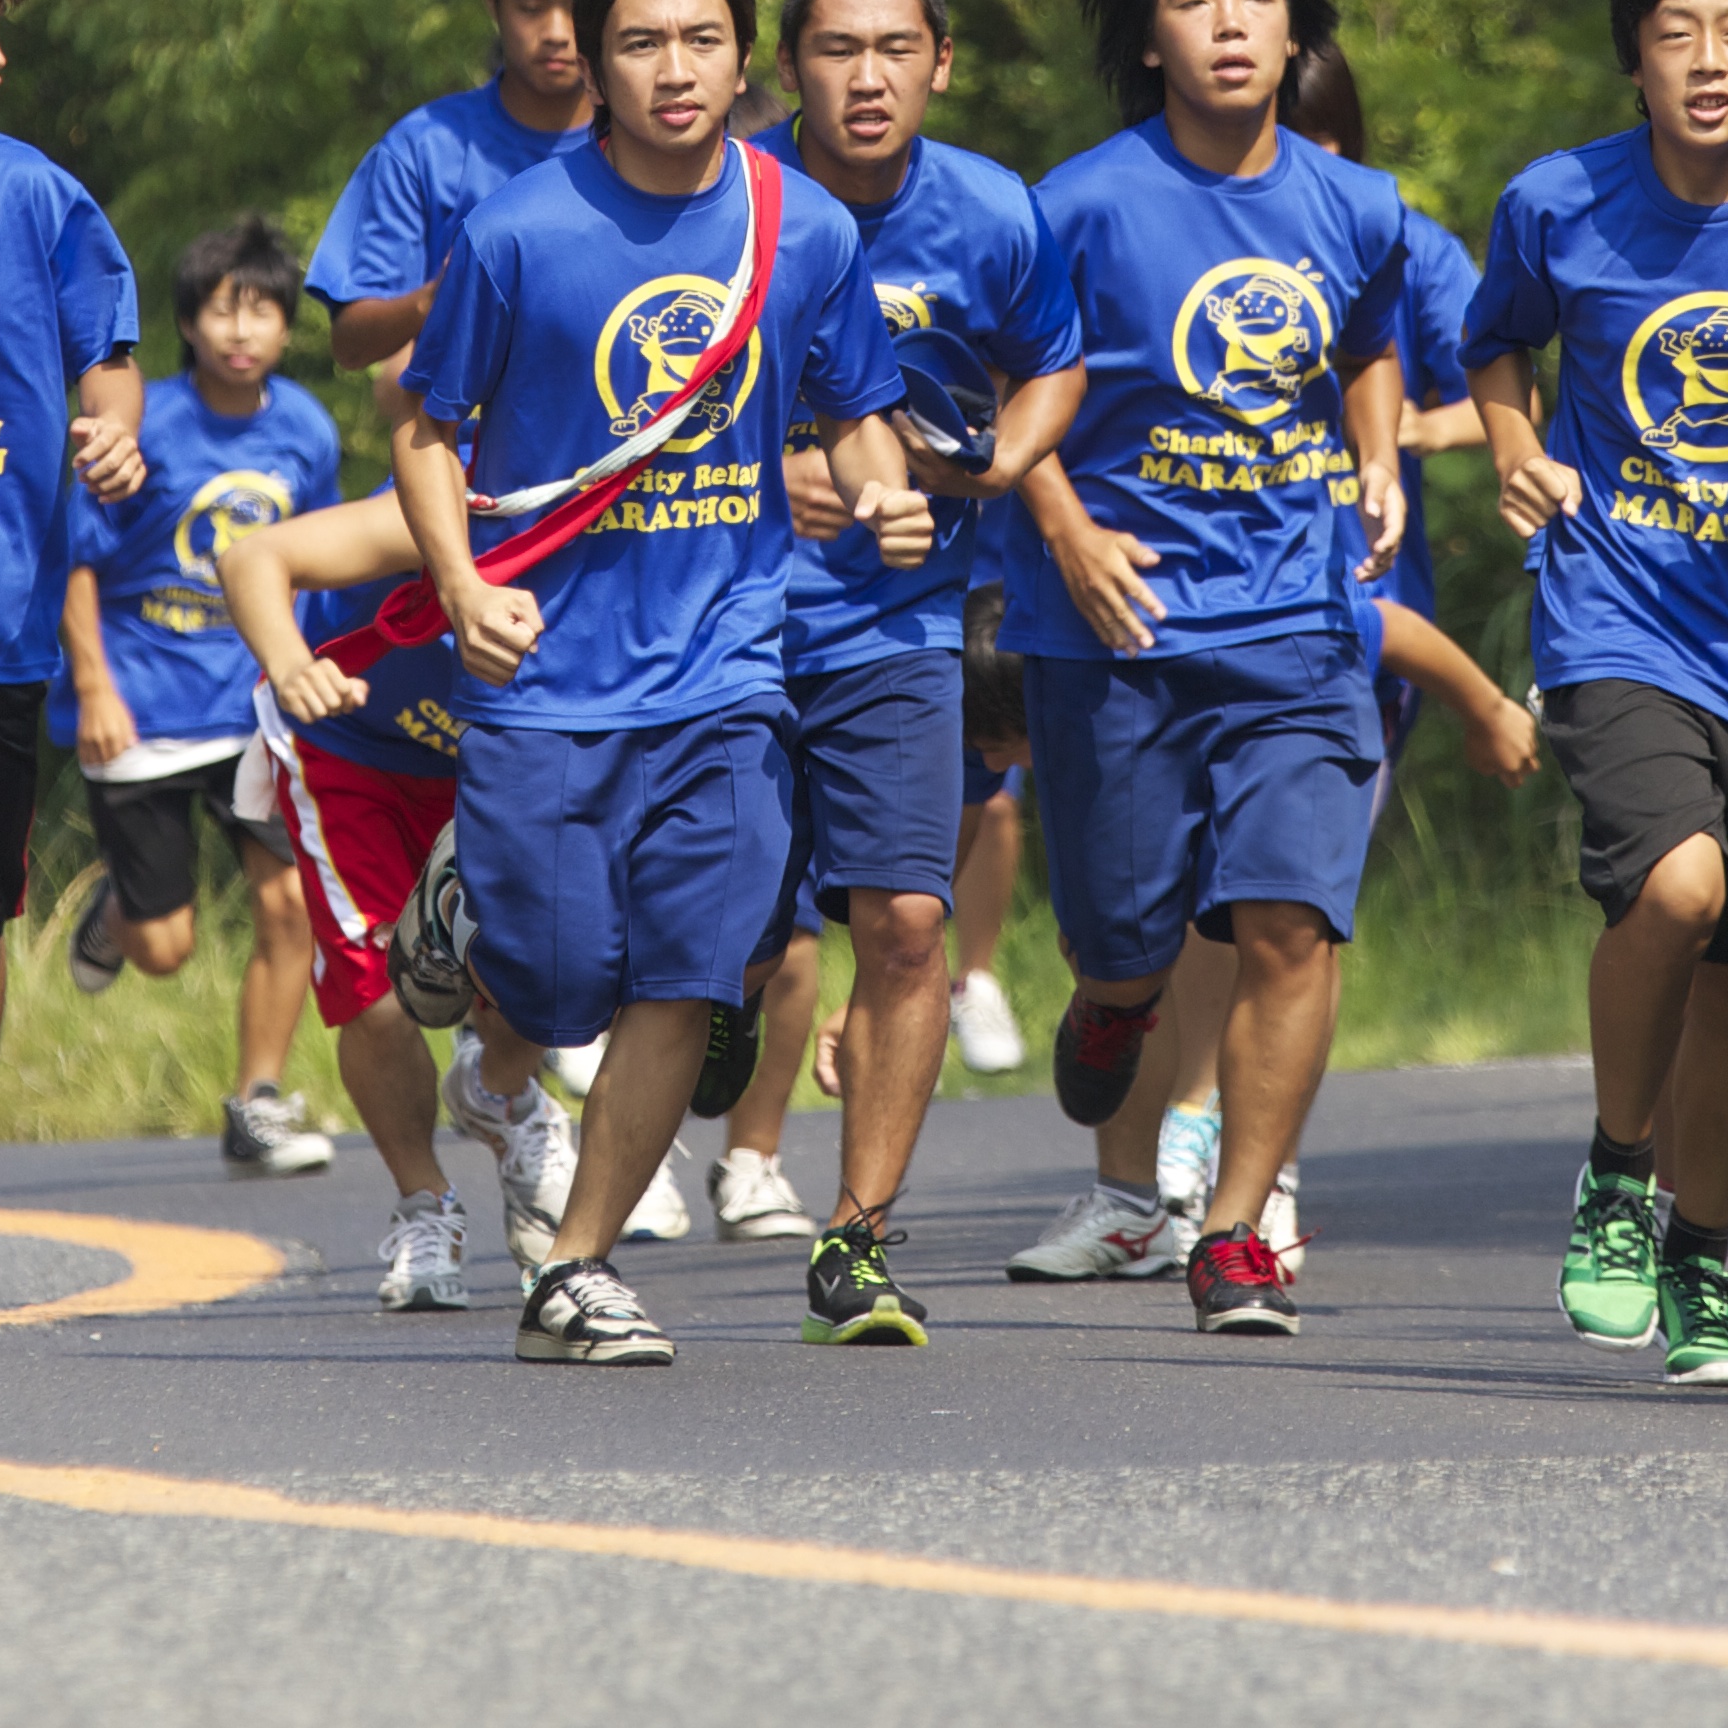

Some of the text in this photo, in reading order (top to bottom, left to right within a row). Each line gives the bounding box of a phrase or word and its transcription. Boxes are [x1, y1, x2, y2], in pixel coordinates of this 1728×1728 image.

[1149, 425, 1264, 461] Charity
[575, 462, 762, 495] rity Relay
[1138, 448, 1326, 491] MARATHON
[583, 490, 761, 534] ARATHON
